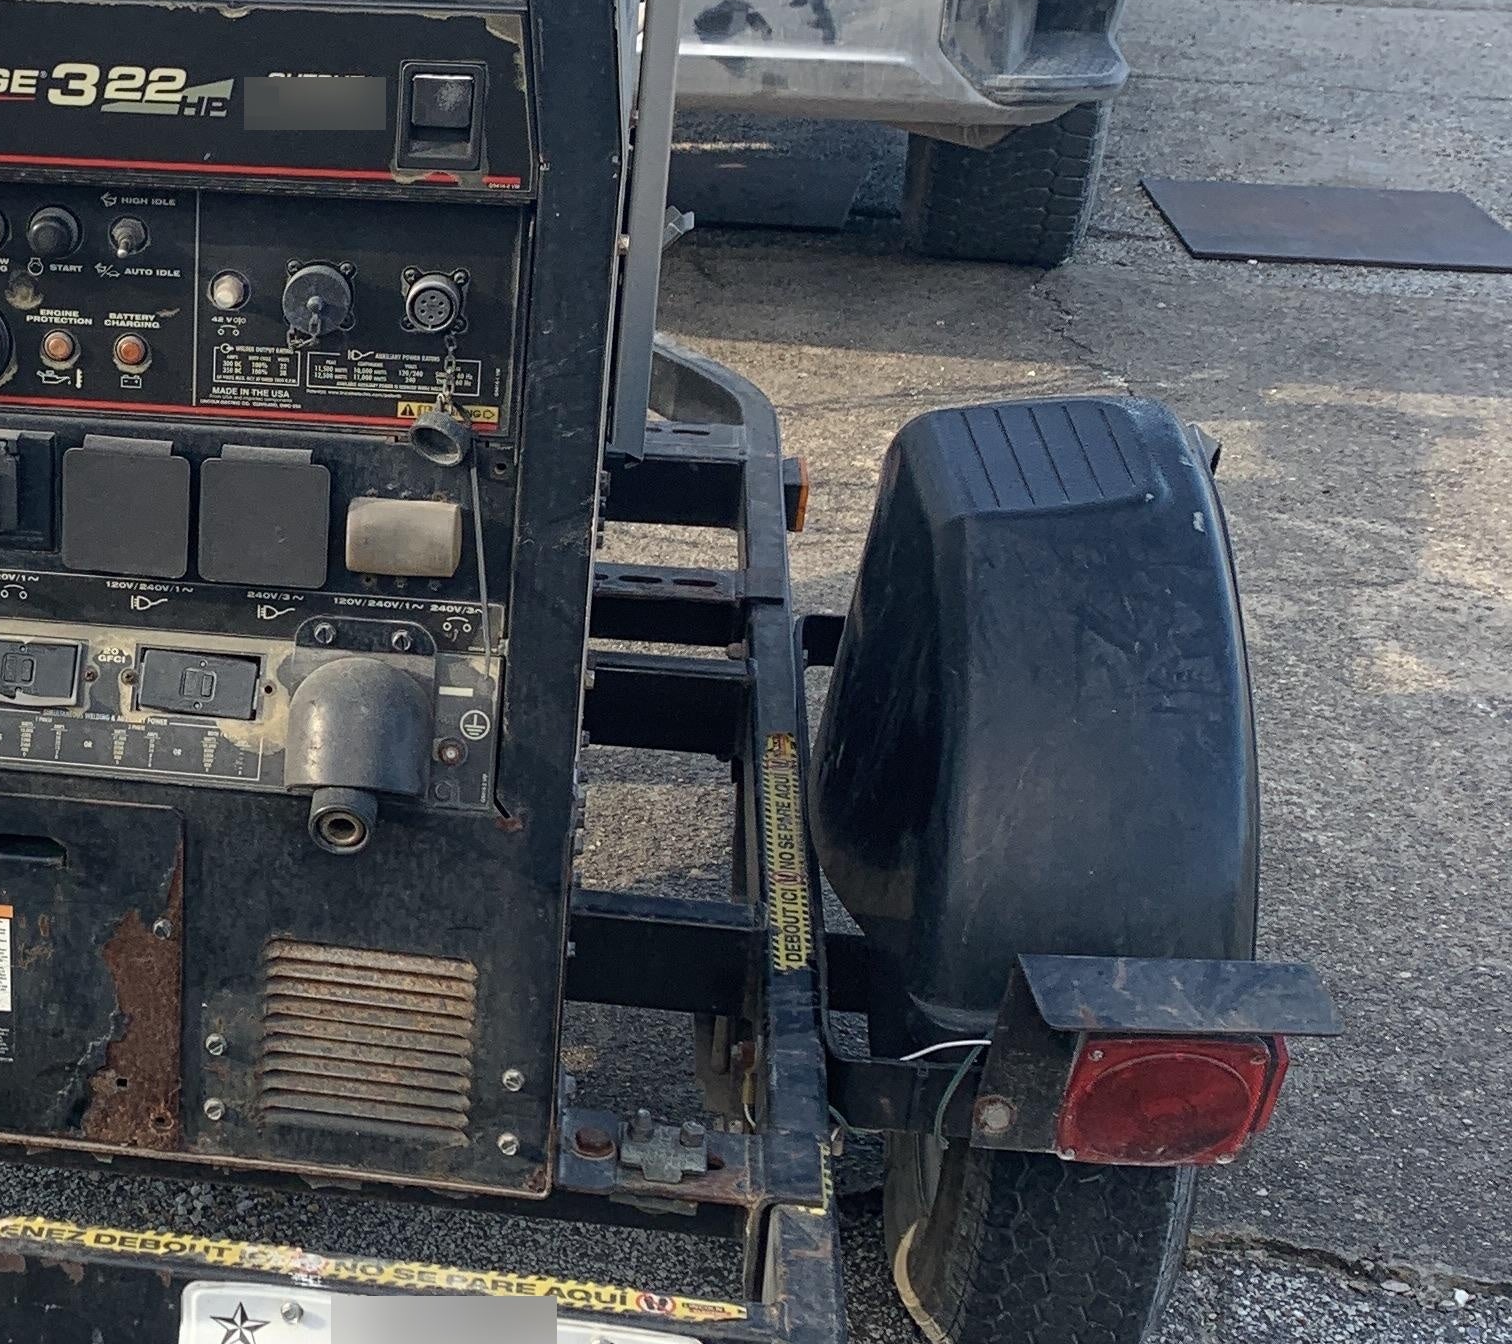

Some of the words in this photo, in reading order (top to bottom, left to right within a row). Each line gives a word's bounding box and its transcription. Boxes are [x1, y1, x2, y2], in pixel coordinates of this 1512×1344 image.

[47, 63, 187, 106] 322
[122, 197, 148, 205] HIGH
[151, 198, 176, 206] IDLE
[50, 264, 83, 273] START
[125, 268, 153, 276] AUTO
[156, 269, 180, 277] IDLE
[40, 309, 79, 317] ENGINE
[109, 313, 156, 321] BATTERY
[26, 316, 93, 325] PROTECTION
[104, 319, 161, 328] CHARGING
[212, 387, 238, 395] MADE
[240, 387, 249, 395] IN
[251, 388, 269, 396] THE
[271, 389, 290, 398] USA
[97, 655, 126, 663] GFCI
[147, 718, 169, 726] POWER
[83, 740, 93, 748] OR
[776, 799, 792, 832] PARE
[778, 834, 794, 852] SE
[779, 854, 796, 870] NO
[782, 887, 799, 906] ICI
[783, 908, 802, 962] DEBOUT
[333, 1261, 383, 1278] NO
[393, 1267, 437, 1285] SE
[446, 1274, 536, 1297] PARE
[548, 1285, 627, 1307] AQUÍ
